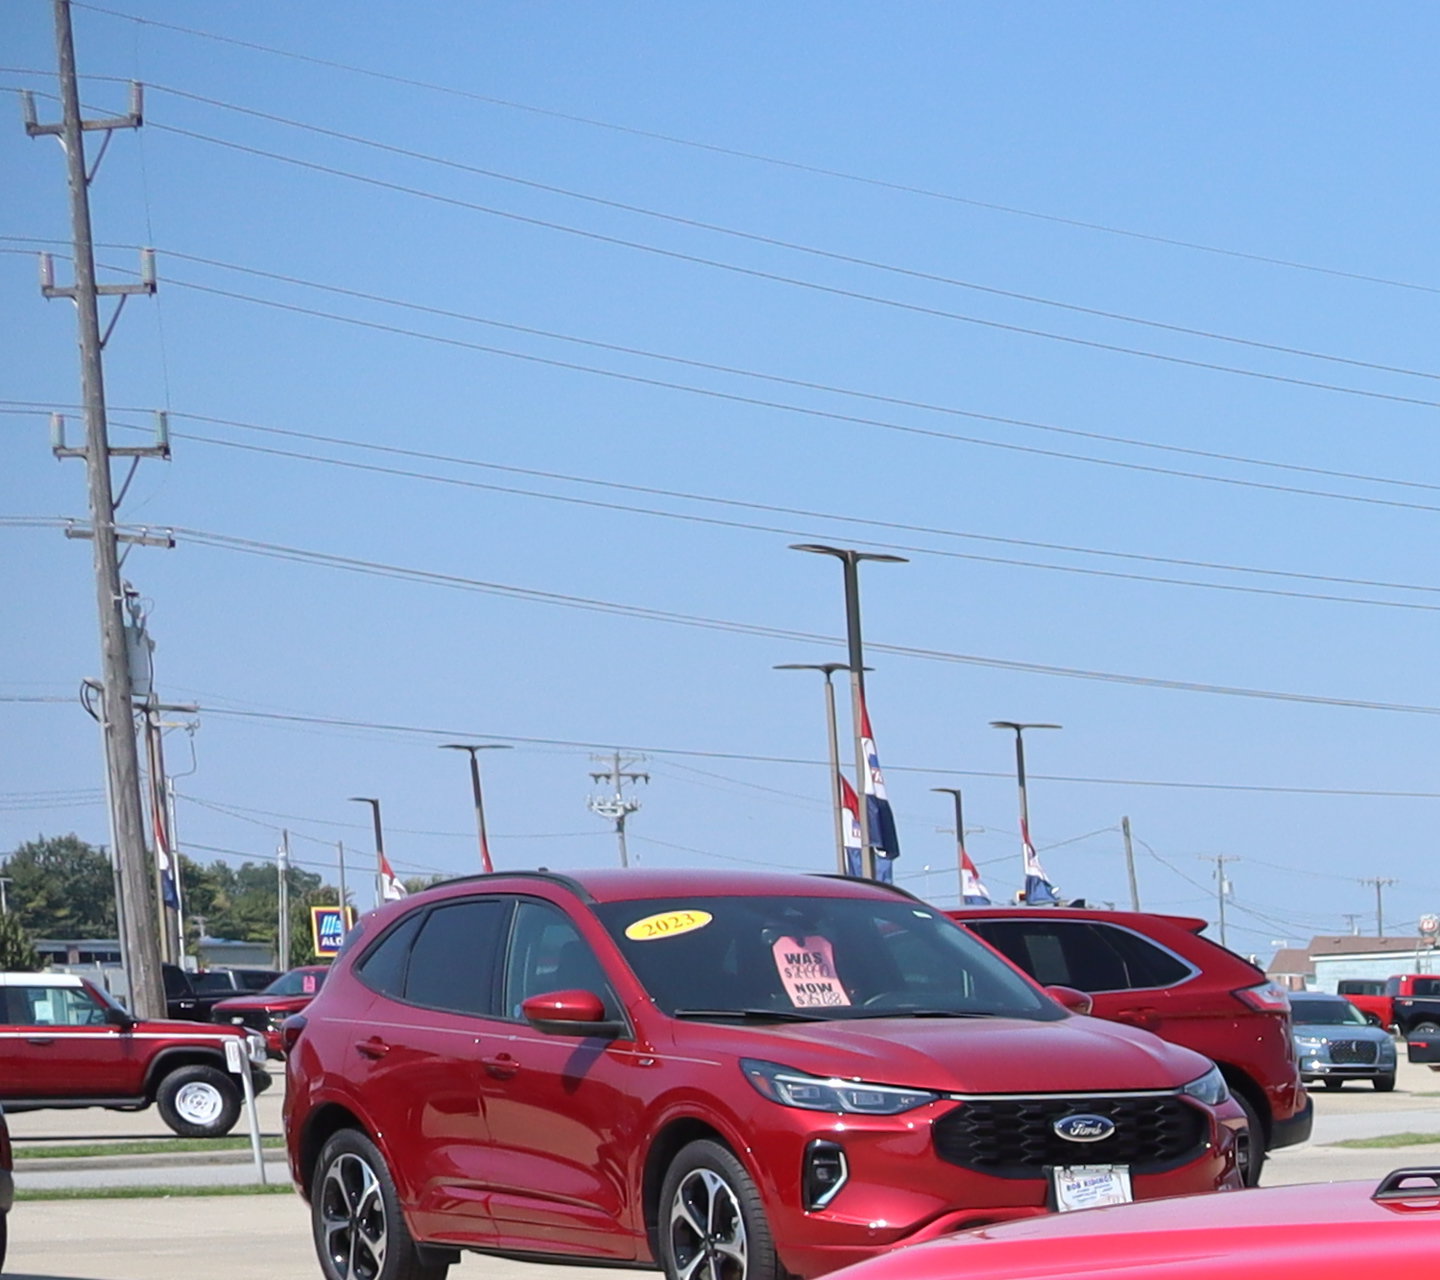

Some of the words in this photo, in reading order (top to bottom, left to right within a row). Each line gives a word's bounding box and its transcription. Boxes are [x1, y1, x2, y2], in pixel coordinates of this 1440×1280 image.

[642, 913, 695, 937] 2023
[321, 936, 344, 946] ALD
[784, 952, 823, 965] WAS
[794, 983, 833, 994] NOW
[1070, 1121, 1102, 1136] Ford
